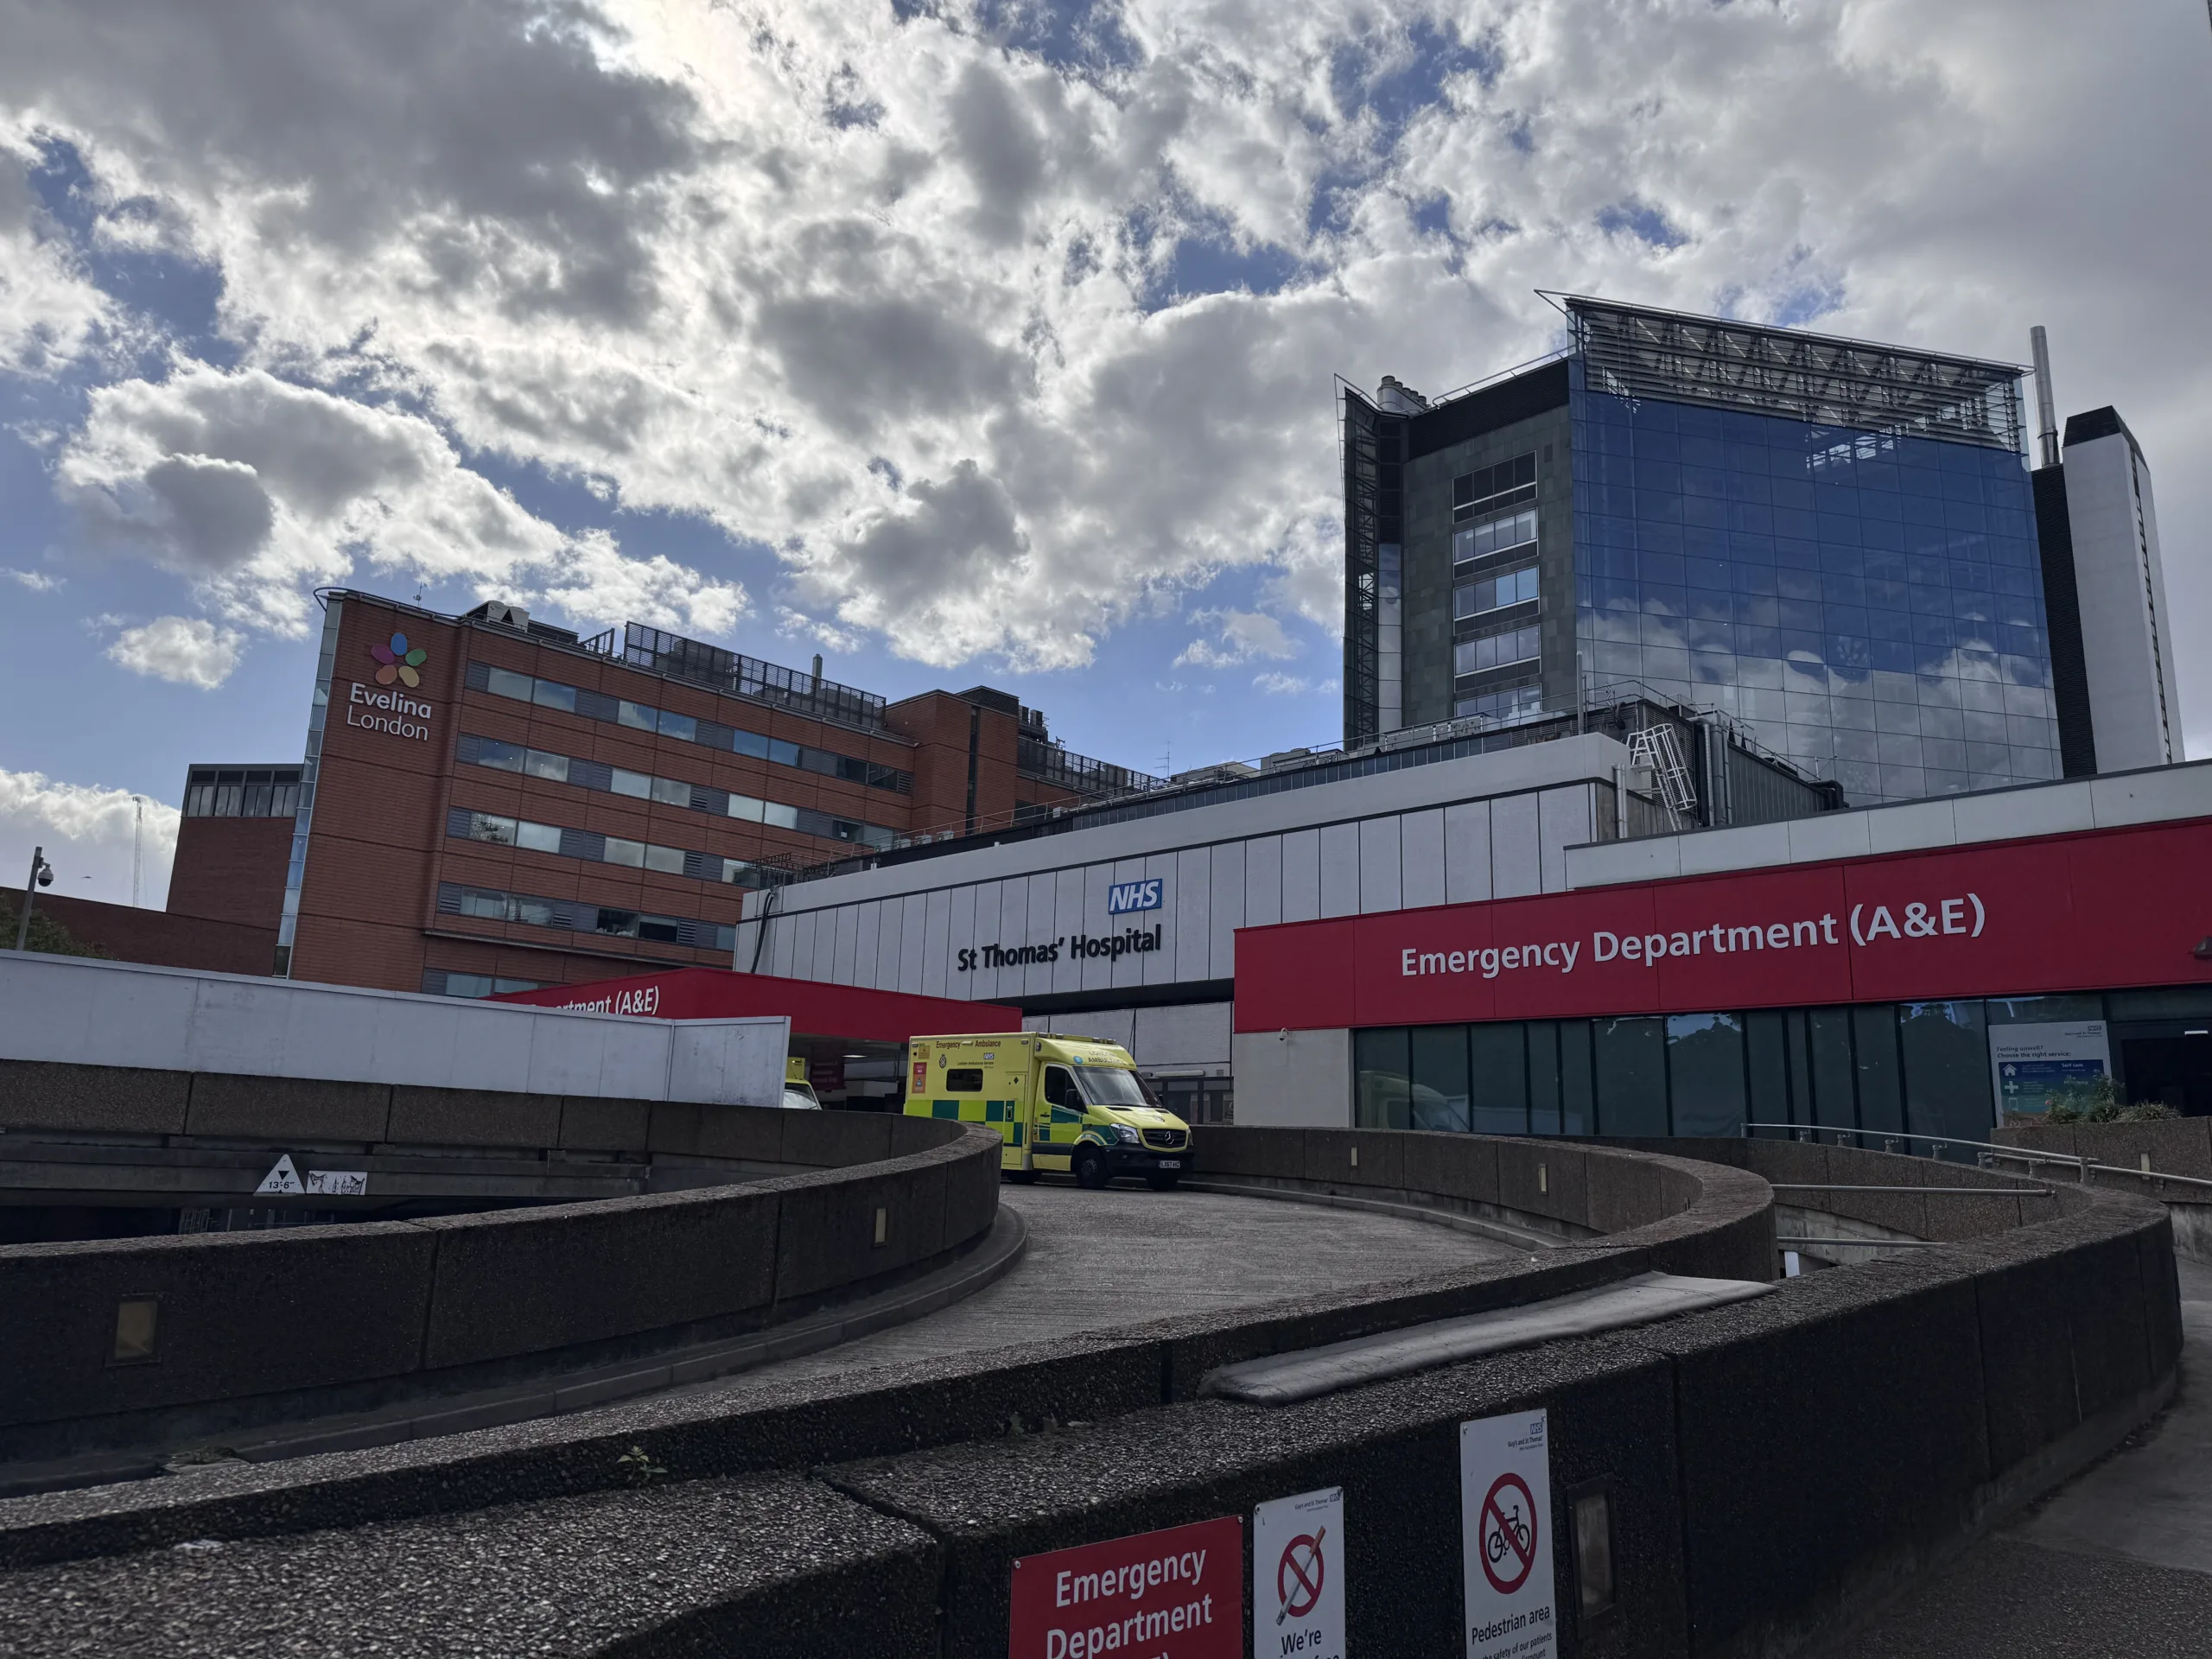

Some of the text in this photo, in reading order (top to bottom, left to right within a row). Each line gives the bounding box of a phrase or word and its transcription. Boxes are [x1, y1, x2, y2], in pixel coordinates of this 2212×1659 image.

[350, 683, 432, 720] Evelina
[346, 705, 429, 741] London
[1109, 880, 1160, 912] NHS
[957, 924, 1161, 972] St Thomas' Hospital
[1401, 892, 1987, 979] Emergency Department (A&E)
[614, 985, 659, 1015] (A&E)
[936, 1039, 1001, 1050] Emergency Ambulance
[1530, 1423, 1542, 1434] NHS
[1056, 1548, 1207, 1608] Emergency
[1046, 1592, 1212, 1659] Department
[1281, 1629, 1322, 1656] We're
[1471, 1605, 1550, 1645] Pedestrian area
[1493, 1648, 1511, 1659] safety
[1512, 1643, 1518, 1654] of
[1519, 1641, 1529, 1651] our
[1530, 1631, 1552, 1649] patients
